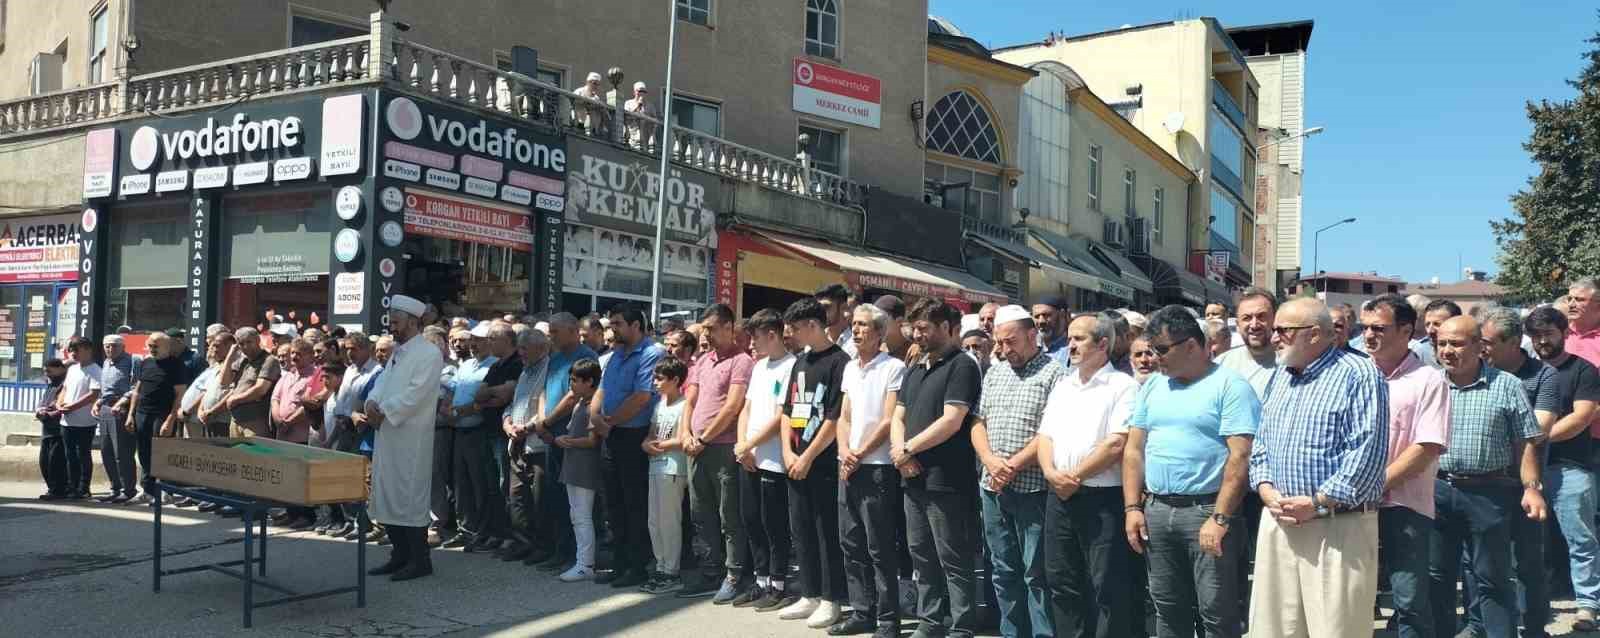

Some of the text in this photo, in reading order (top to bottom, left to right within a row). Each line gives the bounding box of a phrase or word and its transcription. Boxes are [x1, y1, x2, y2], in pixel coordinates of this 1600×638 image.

[162, 113, 302, 160] vodafone
[428, 114, 566, 172] vodafone
[127, 180, 148, 190] iPhone
[158, 176, 185, 186] SAMSUNG
[394, 165, 419, 178] iPhone
[428, 173, 459, 185] SAMSUNG
[193, 198, 204, 260] FATURA
[587, 184, 700, 236] KEMAL
[191, 265, 203, 320] ÖDEME
